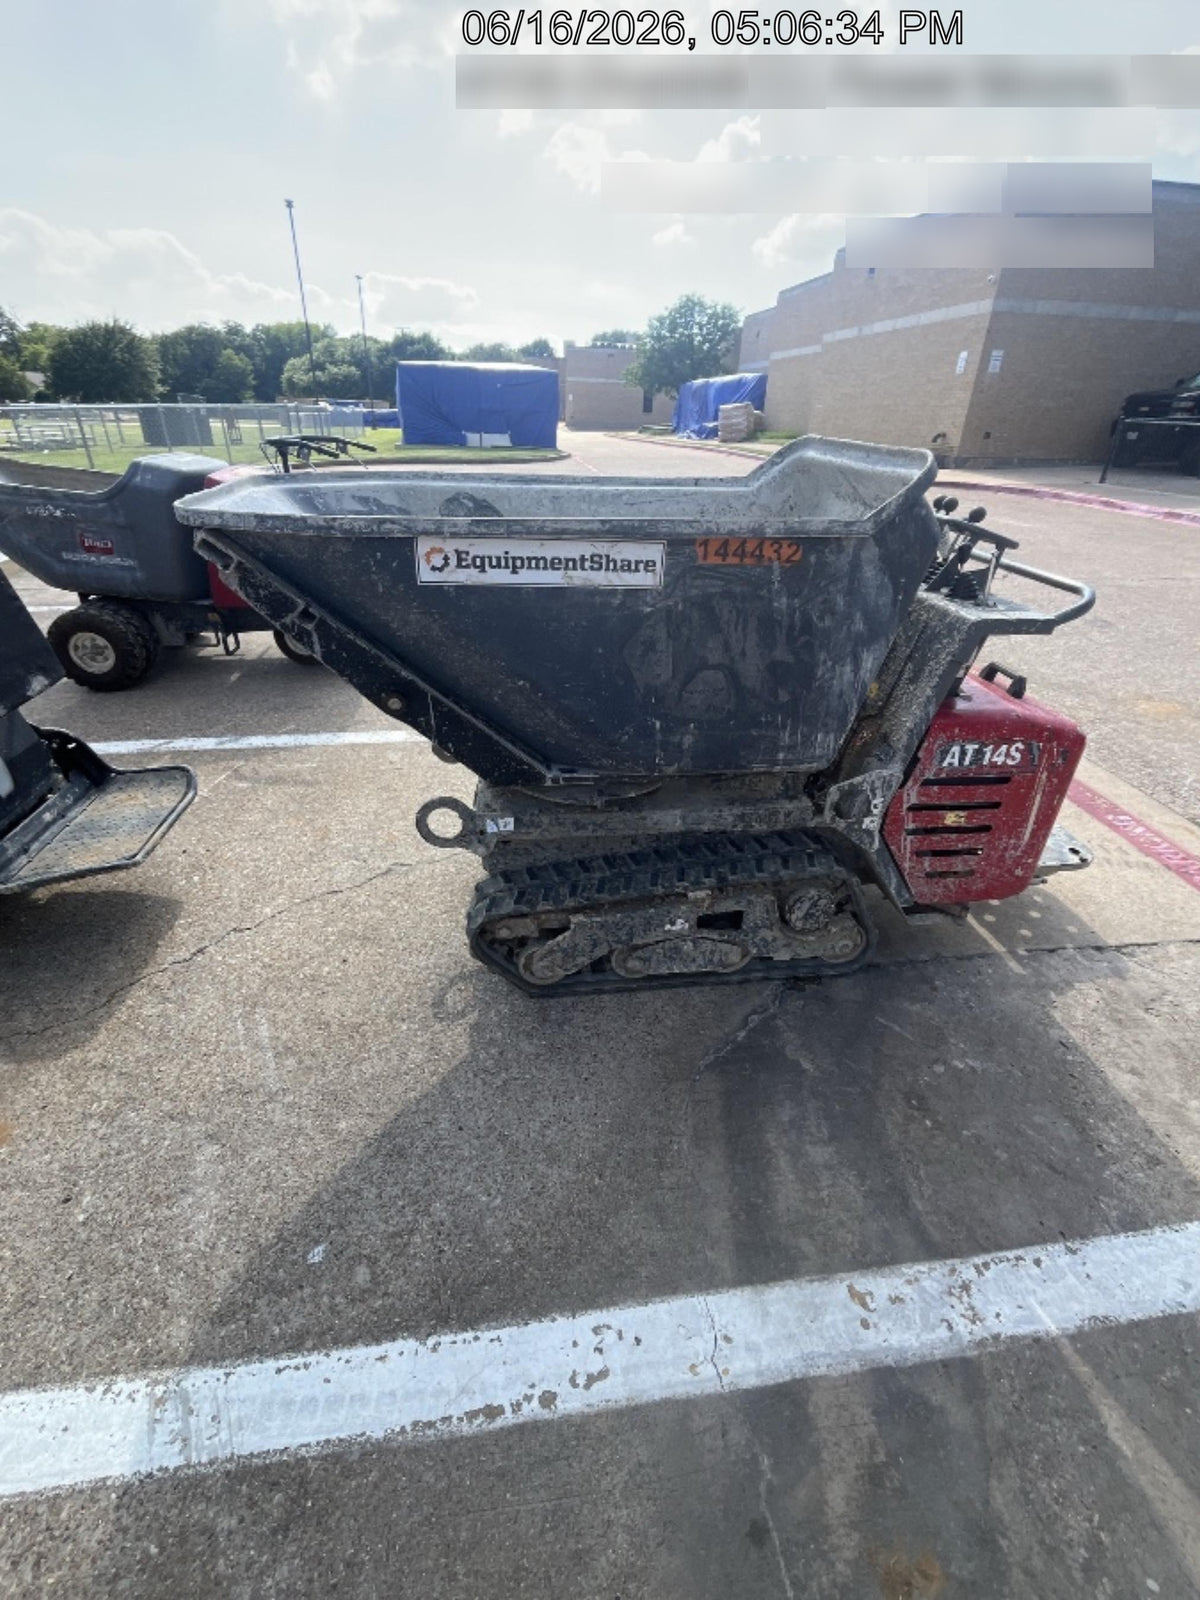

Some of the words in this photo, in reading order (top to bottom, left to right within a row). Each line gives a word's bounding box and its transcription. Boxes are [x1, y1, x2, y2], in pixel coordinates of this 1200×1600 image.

[454, 549, 657, 574] EquipmentShare
[698, 538, 802, 563] 144432
[942, 743, 979, 767] AT
[982, 741, 1025, 766] 14S
